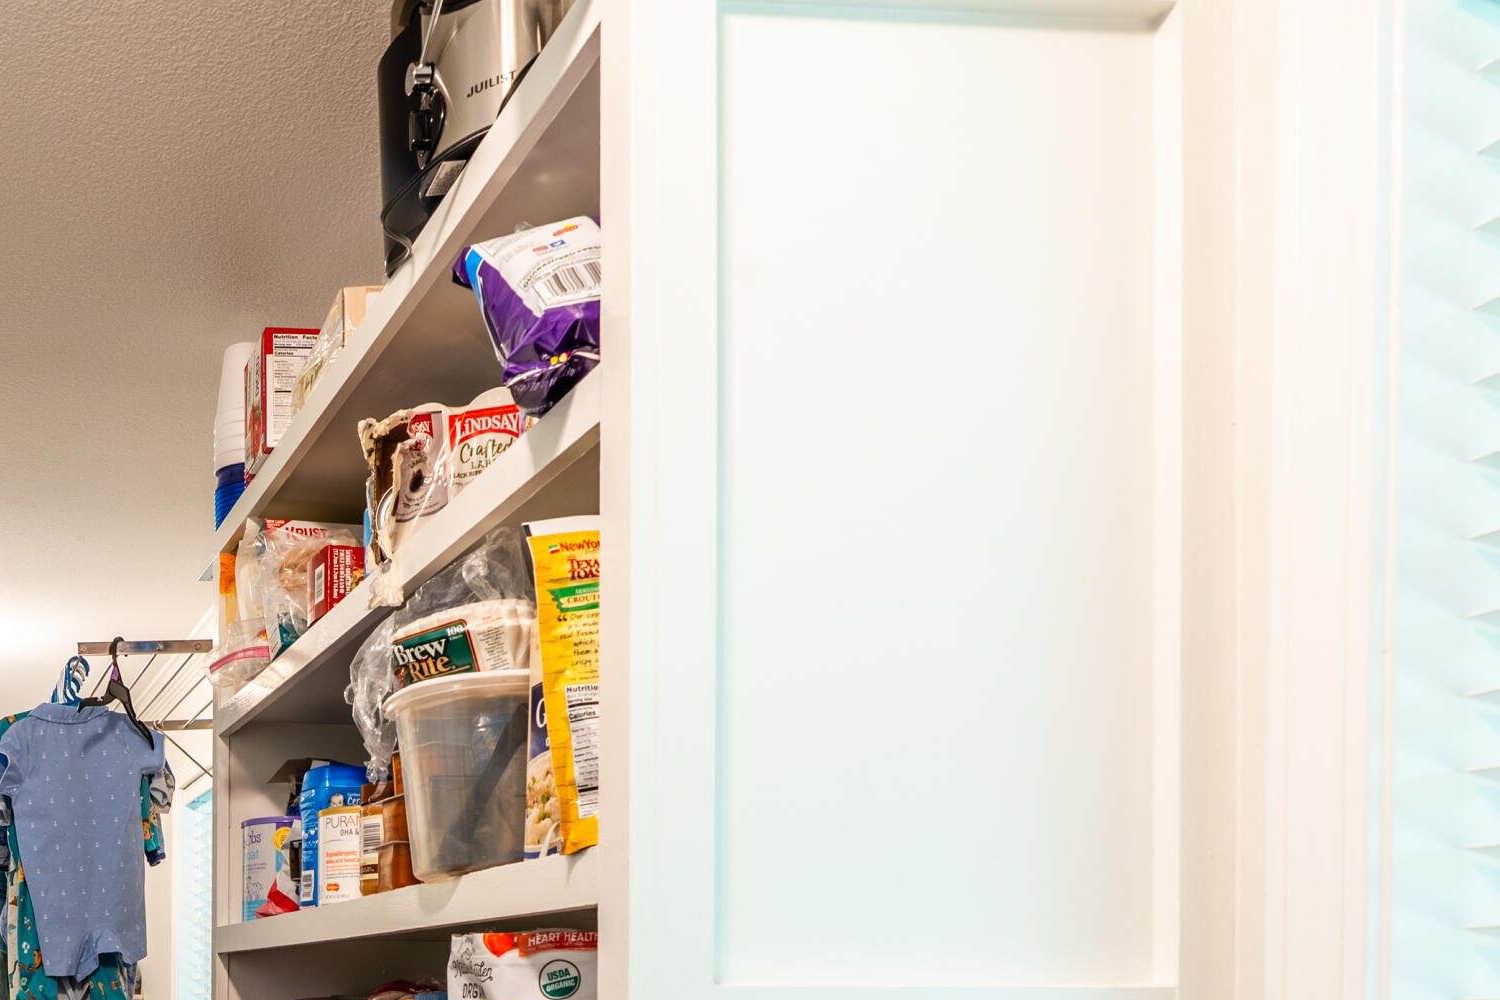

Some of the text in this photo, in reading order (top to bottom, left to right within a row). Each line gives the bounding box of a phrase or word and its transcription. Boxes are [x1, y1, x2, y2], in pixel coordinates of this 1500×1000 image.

[466, 69, 517, 98] JUILIST
[446, 625, 465, 636] 100
[393, 638, 447, 666] Brew
[408, 656, 452, 683] Rite
[568, 709, 597, 720] Calories
[340, 828, 354, 837] DHA
[528, 932, 561, 947] HEART
[546, 967, 571, 981] USDA
[545, 978, 577, 992] ORGANIC
